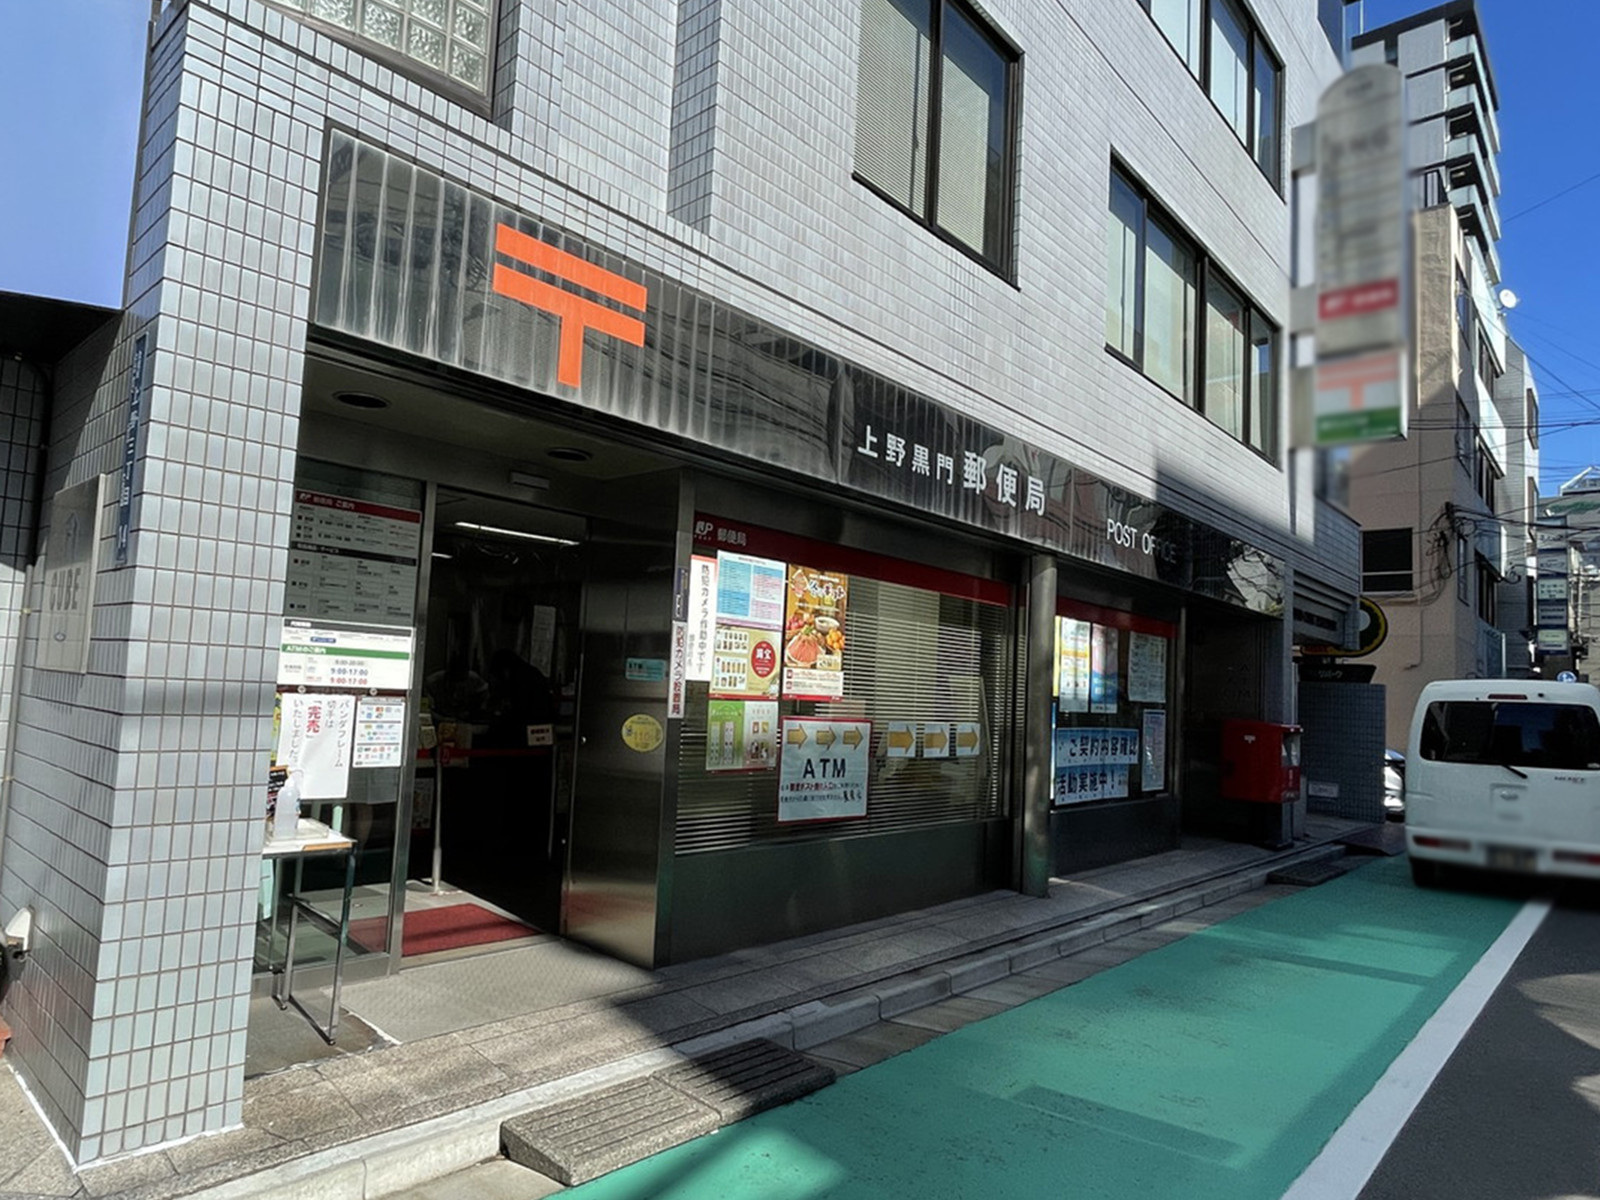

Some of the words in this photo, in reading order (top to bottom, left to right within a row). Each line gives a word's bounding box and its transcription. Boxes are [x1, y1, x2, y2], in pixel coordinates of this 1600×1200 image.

[857, 425, 1046, 517] 上野黒門郵便局
[1107, 518, 1138, 549] POST
[334, 699, 350, 768] パンダフレーム
[803, 758, 846, 779] ATM
